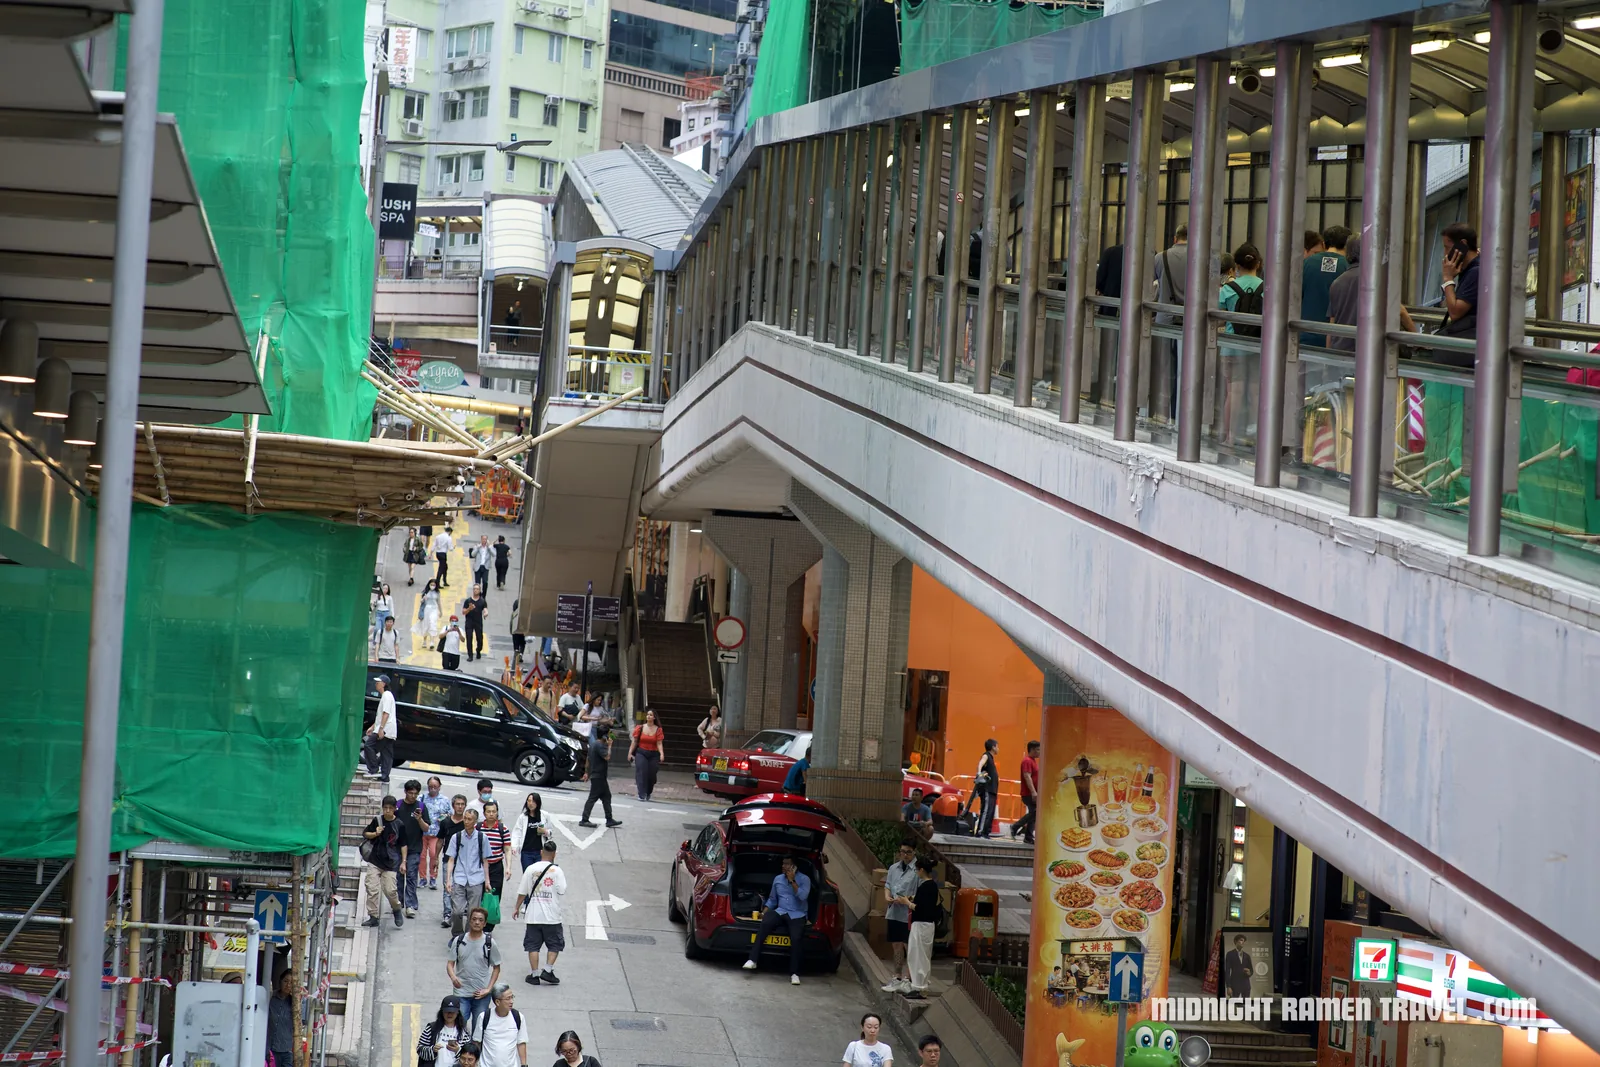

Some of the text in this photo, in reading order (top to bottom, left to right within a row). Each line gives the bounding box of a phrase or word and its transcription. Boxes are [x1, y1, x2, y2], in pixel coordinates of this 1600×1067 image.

[381, 199, 411, 210] USH
[380, 212, 405, 223] SPA
[1080, 942, 1114, 953] 大排檔
